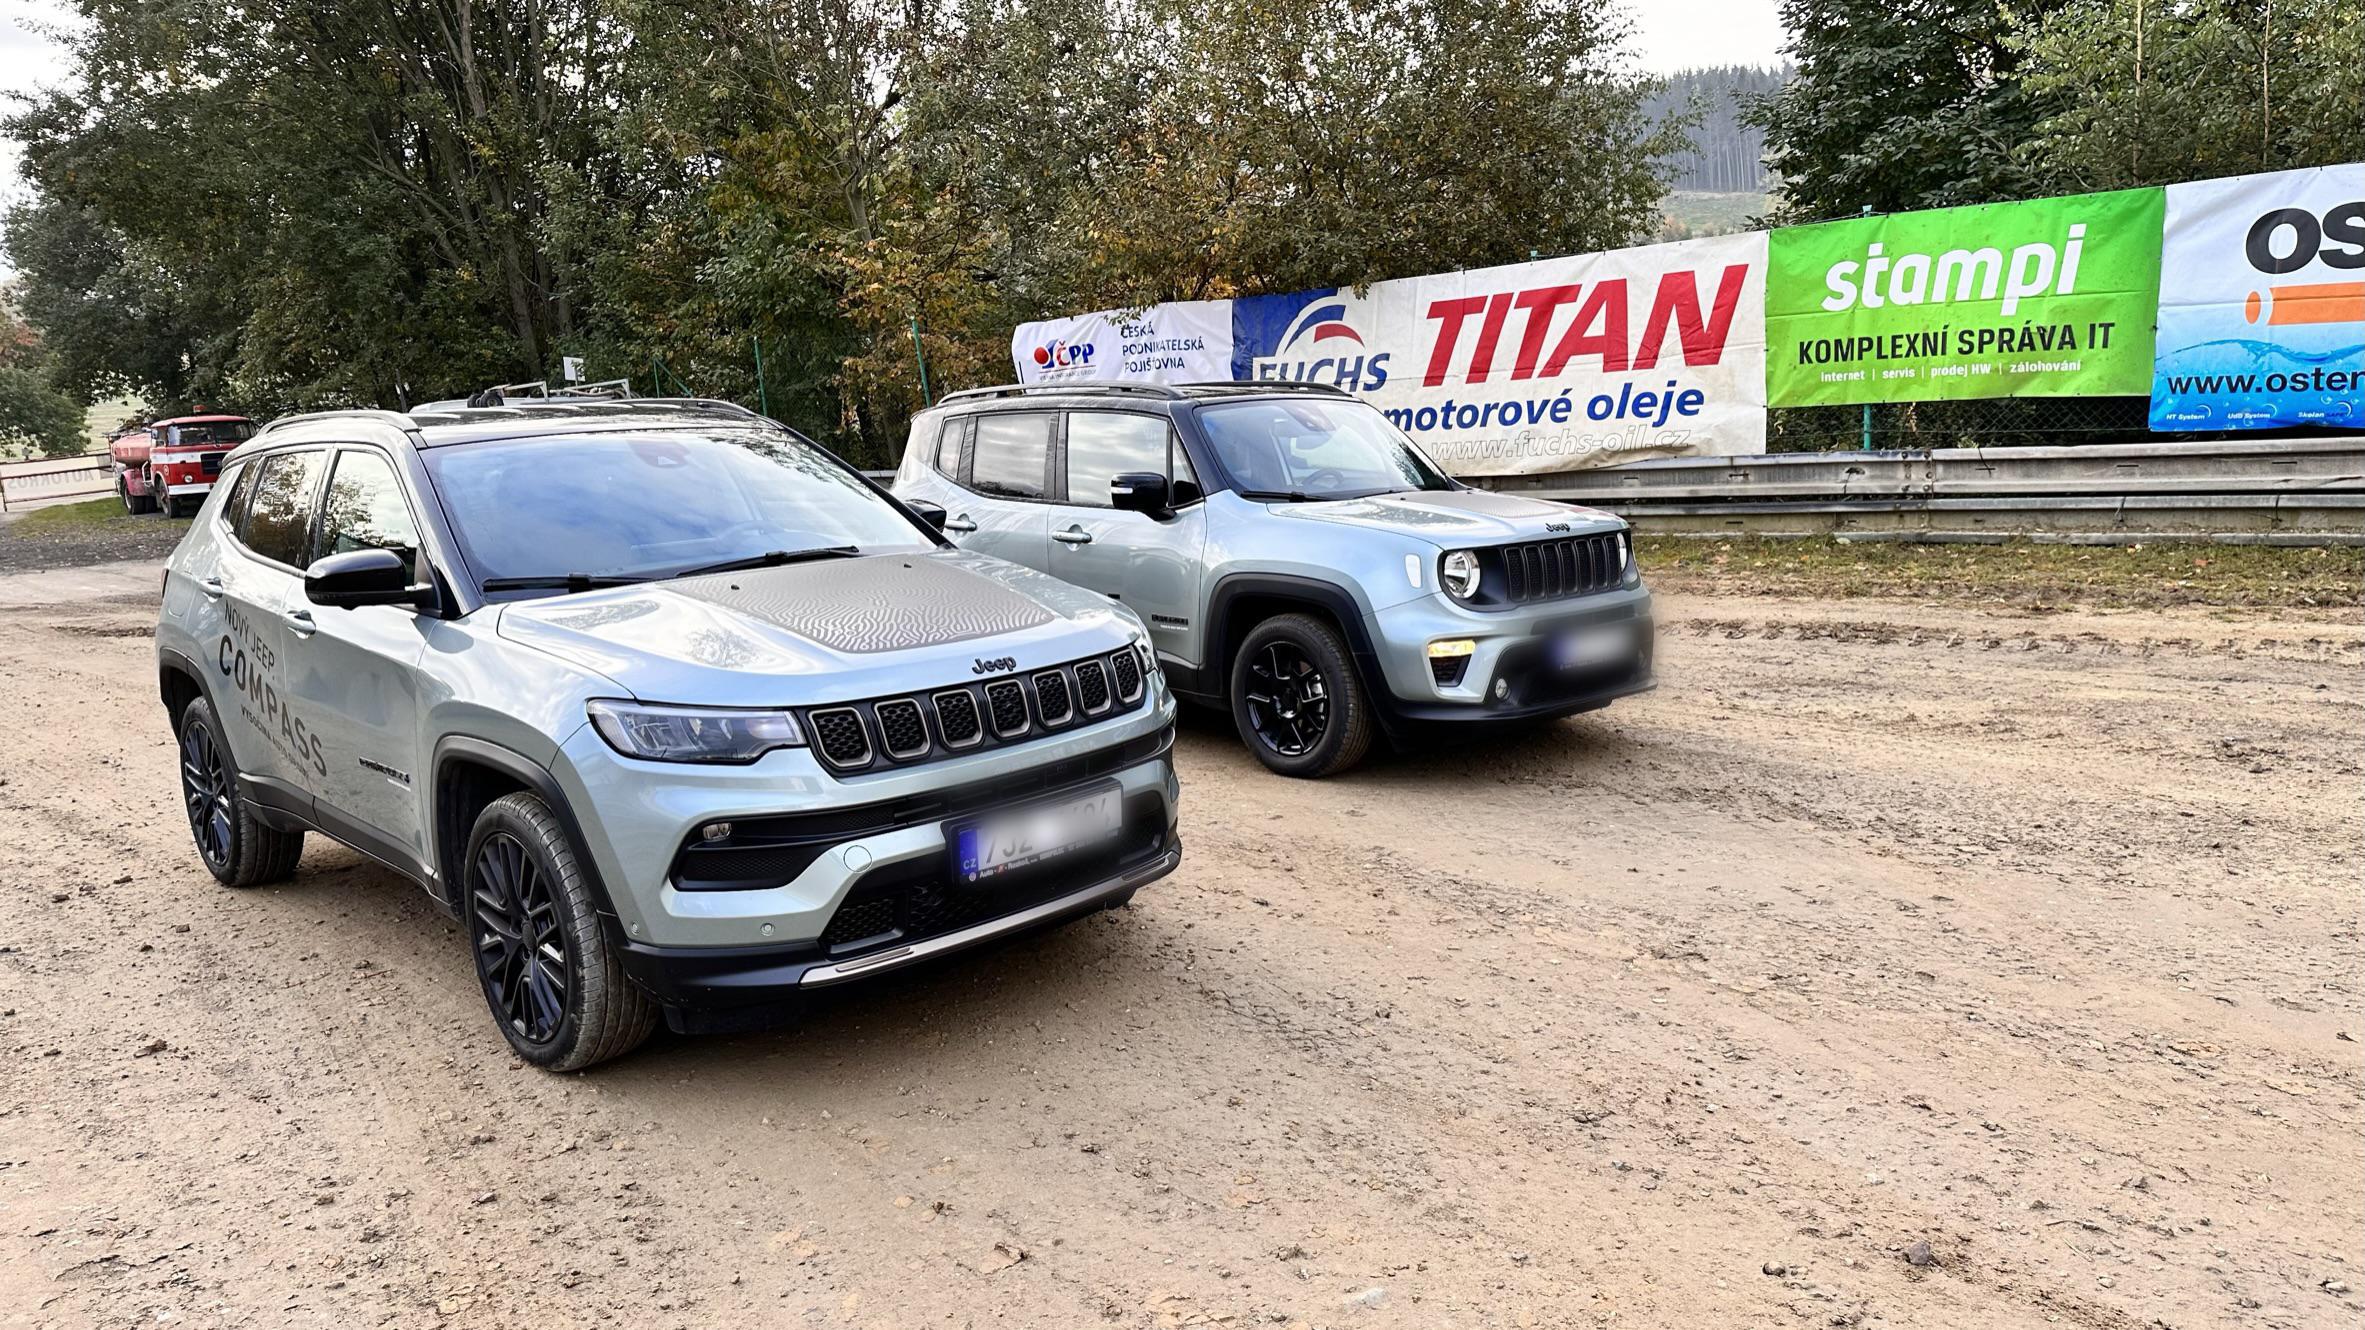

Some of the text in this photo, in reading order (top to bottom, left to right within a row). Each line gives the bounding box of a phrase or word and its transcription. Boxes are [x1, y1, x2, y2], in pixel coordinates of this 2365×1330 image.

[1821, 223, 2087, 316] stampi
[1422, 263, 1749, 388] TITAN
[1799, 320, 2115, 365] KOMPLEXNÍ SPRÁVA IT
[1056, 340, 1095, 367] ČPP
[1122, 336, 1205, 357] PODNIKATELSKÁ
[1259, 352, 1391, 393] FUCHS
[1821, 360, 2082, 383] internet servis prodej HW zálohování
[1384, 380, 1705, 432] motorové oleje
[1431, 424, 1691, 461] www.fuchs-oil.cz
[1545, 522, 1570, 533] Jeep
[224, 600, 275, 673] NOVÝ JEEP
[971, 656, 1017, 675] Jeep
[219, 634, 328, 778] COMPASS
[962, 858, 977, 870] CZ
